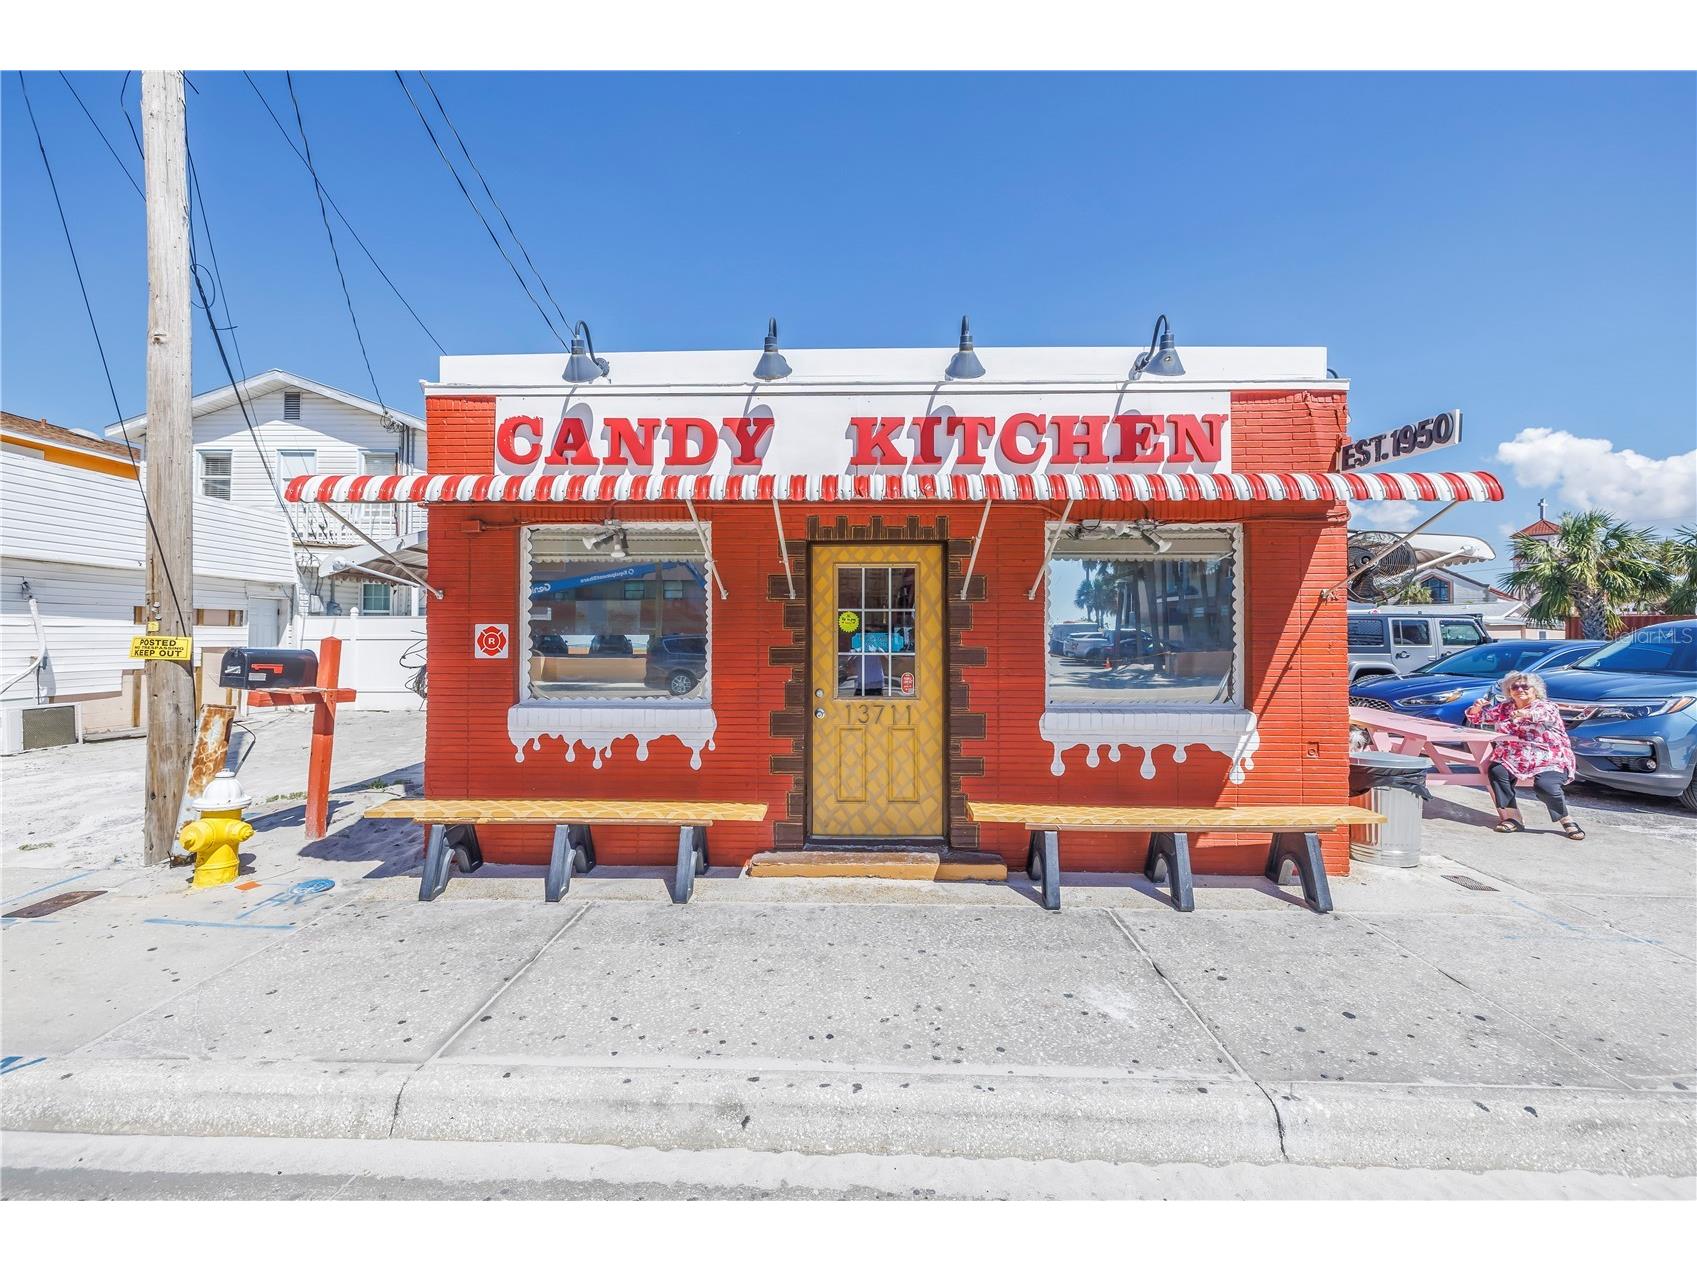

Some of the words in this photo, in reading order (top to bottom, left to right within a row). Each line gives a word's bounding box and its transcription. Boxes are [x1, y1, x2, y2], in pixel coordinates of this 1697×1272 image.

[497, 414, 775, 466] CANDY
[850, 412, 1229, 466] KITCHEN
[140, 639, 177, 647] POSTED
[488, 637, 496, 645] R
[134, 649, 156, 657] KEEP
[845, 704, 912, 726] 13711
